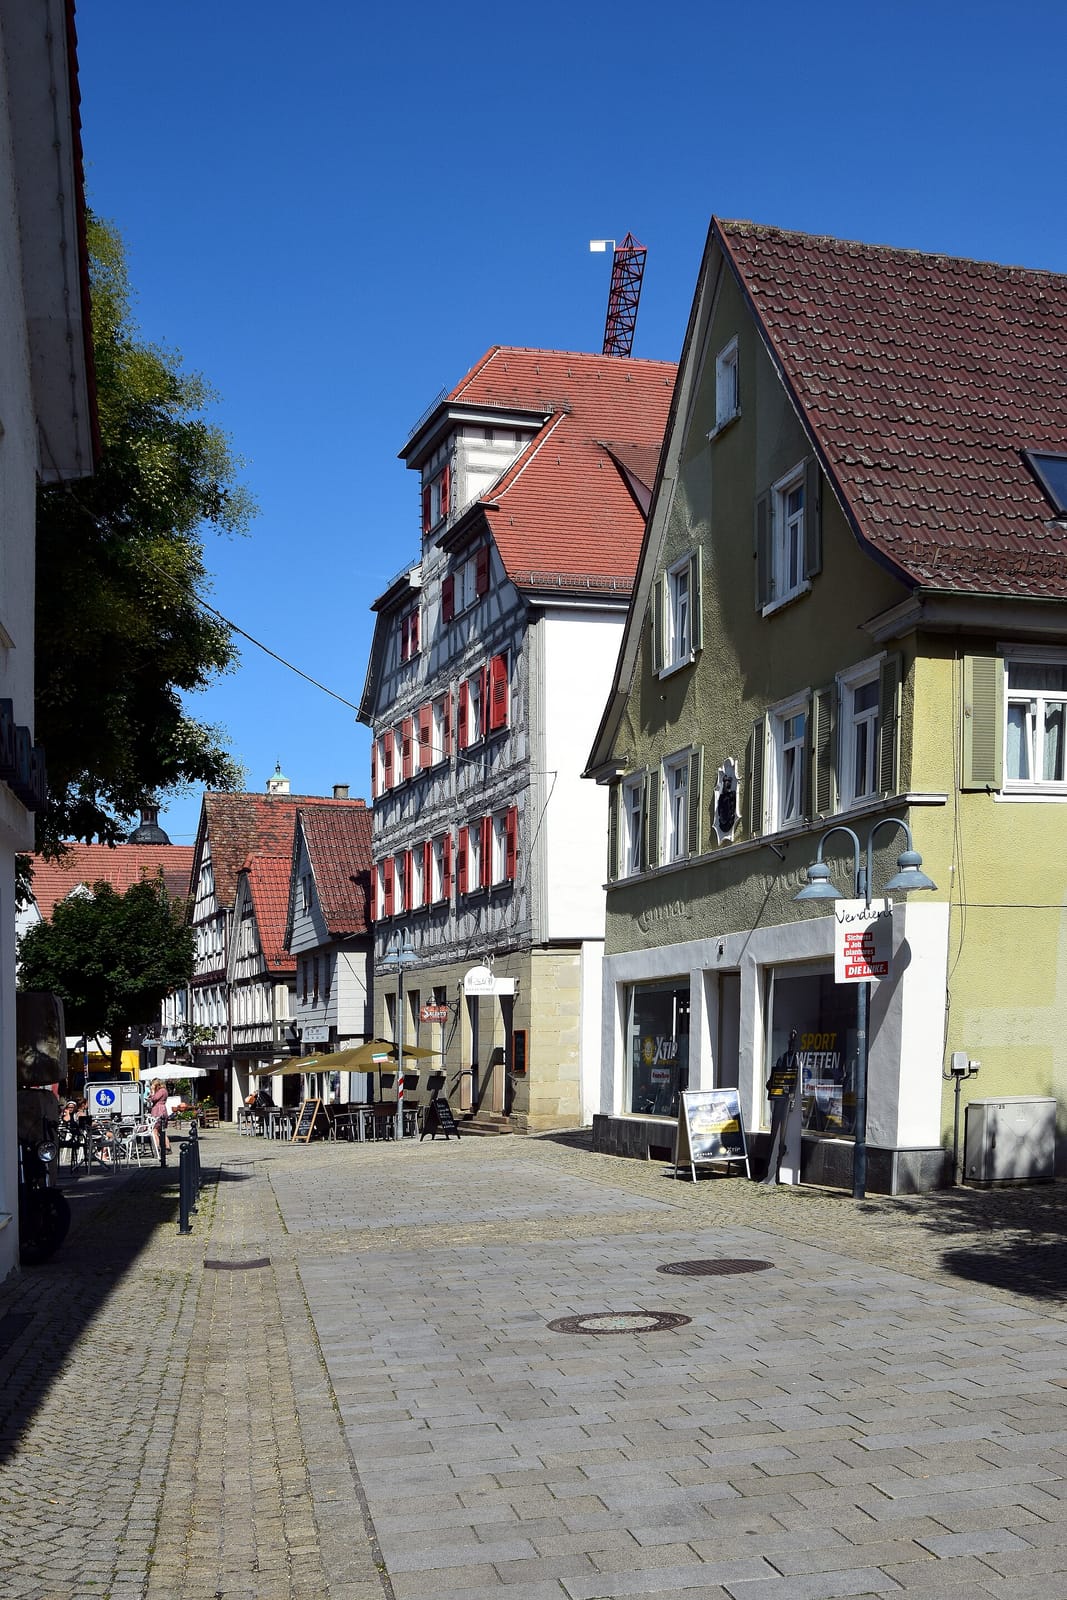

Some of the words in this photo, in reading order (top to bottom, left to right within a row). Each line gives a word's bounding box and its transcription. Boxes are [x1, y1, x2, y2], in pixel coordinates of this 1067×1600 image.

[848, 966, 863, 976] DIE
[800, 1032, 837, 1051] SPORT
[796, 1051, 841, 1069] WETTEN
